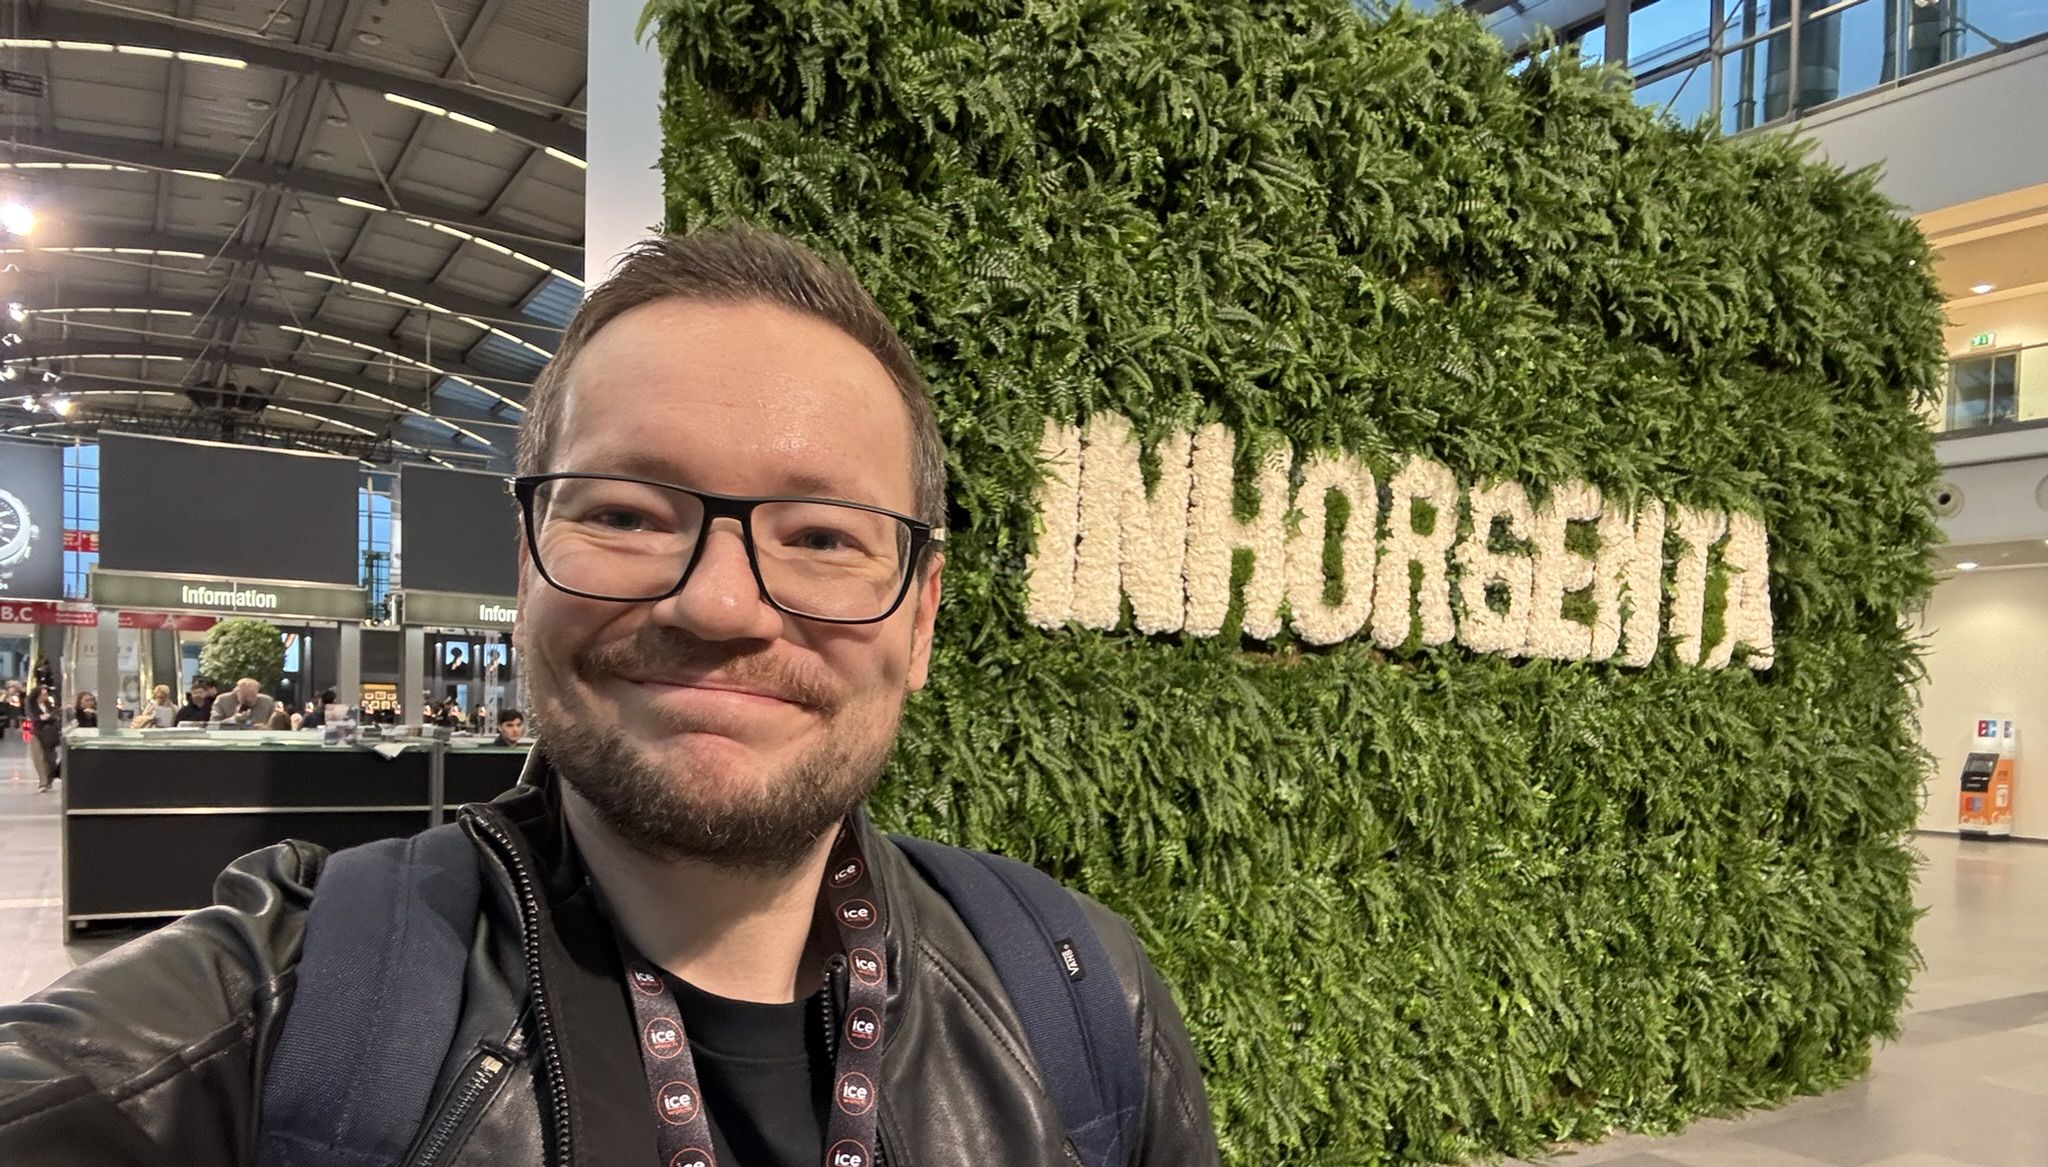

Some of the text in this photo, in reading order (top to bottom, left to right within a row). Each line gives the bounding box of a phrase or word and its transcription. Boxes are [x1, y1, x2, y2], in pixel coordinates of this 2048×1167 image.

[1025, 409, 1775, 671] INHORGENTA
[182, 585, 277, 608] Information
[162, 615, 178, 628] A
[834, 864, 857, 881] ice
[843, 907, 869, 920] ice
[855, 956, 877, 972] ice
[634, 972, 655, 982] ice
[852, 1016, 875, 1033] ice
[650, 1029, 676, 1044] ice
[843, 1082, 868, 1100] ice
[664, 1094, 691, 1111] ice
[834, 1150, 862, 1166] ice
